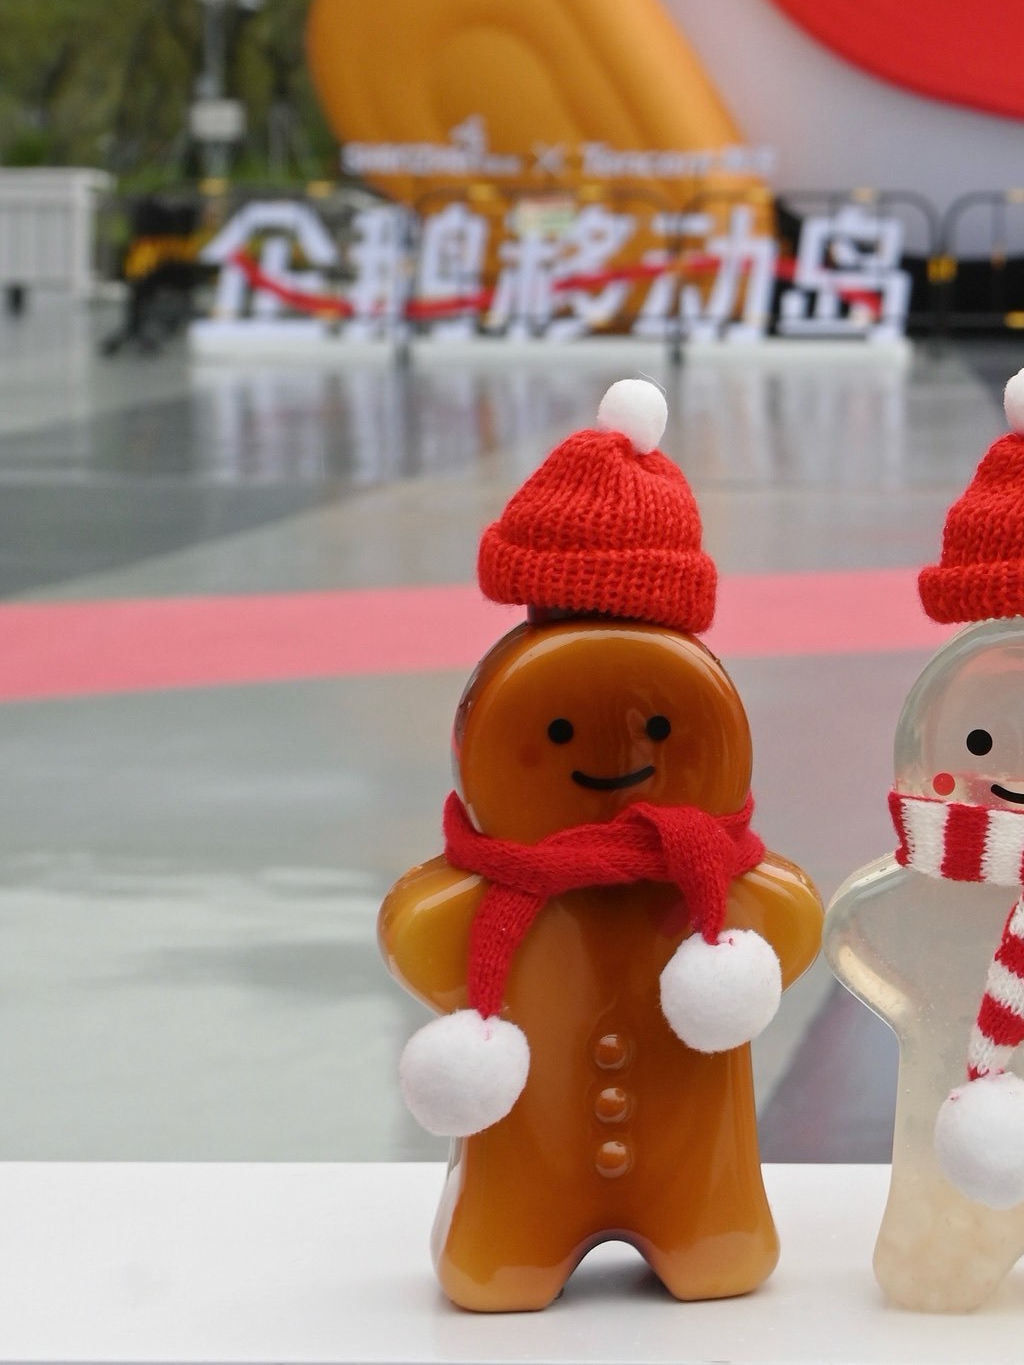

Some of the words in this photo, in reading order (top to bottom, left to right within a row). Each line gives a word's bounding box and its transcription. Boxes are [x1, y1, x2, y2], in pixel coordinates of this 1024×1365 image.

[201, 200, 911, 339] 企鹅移动岛
